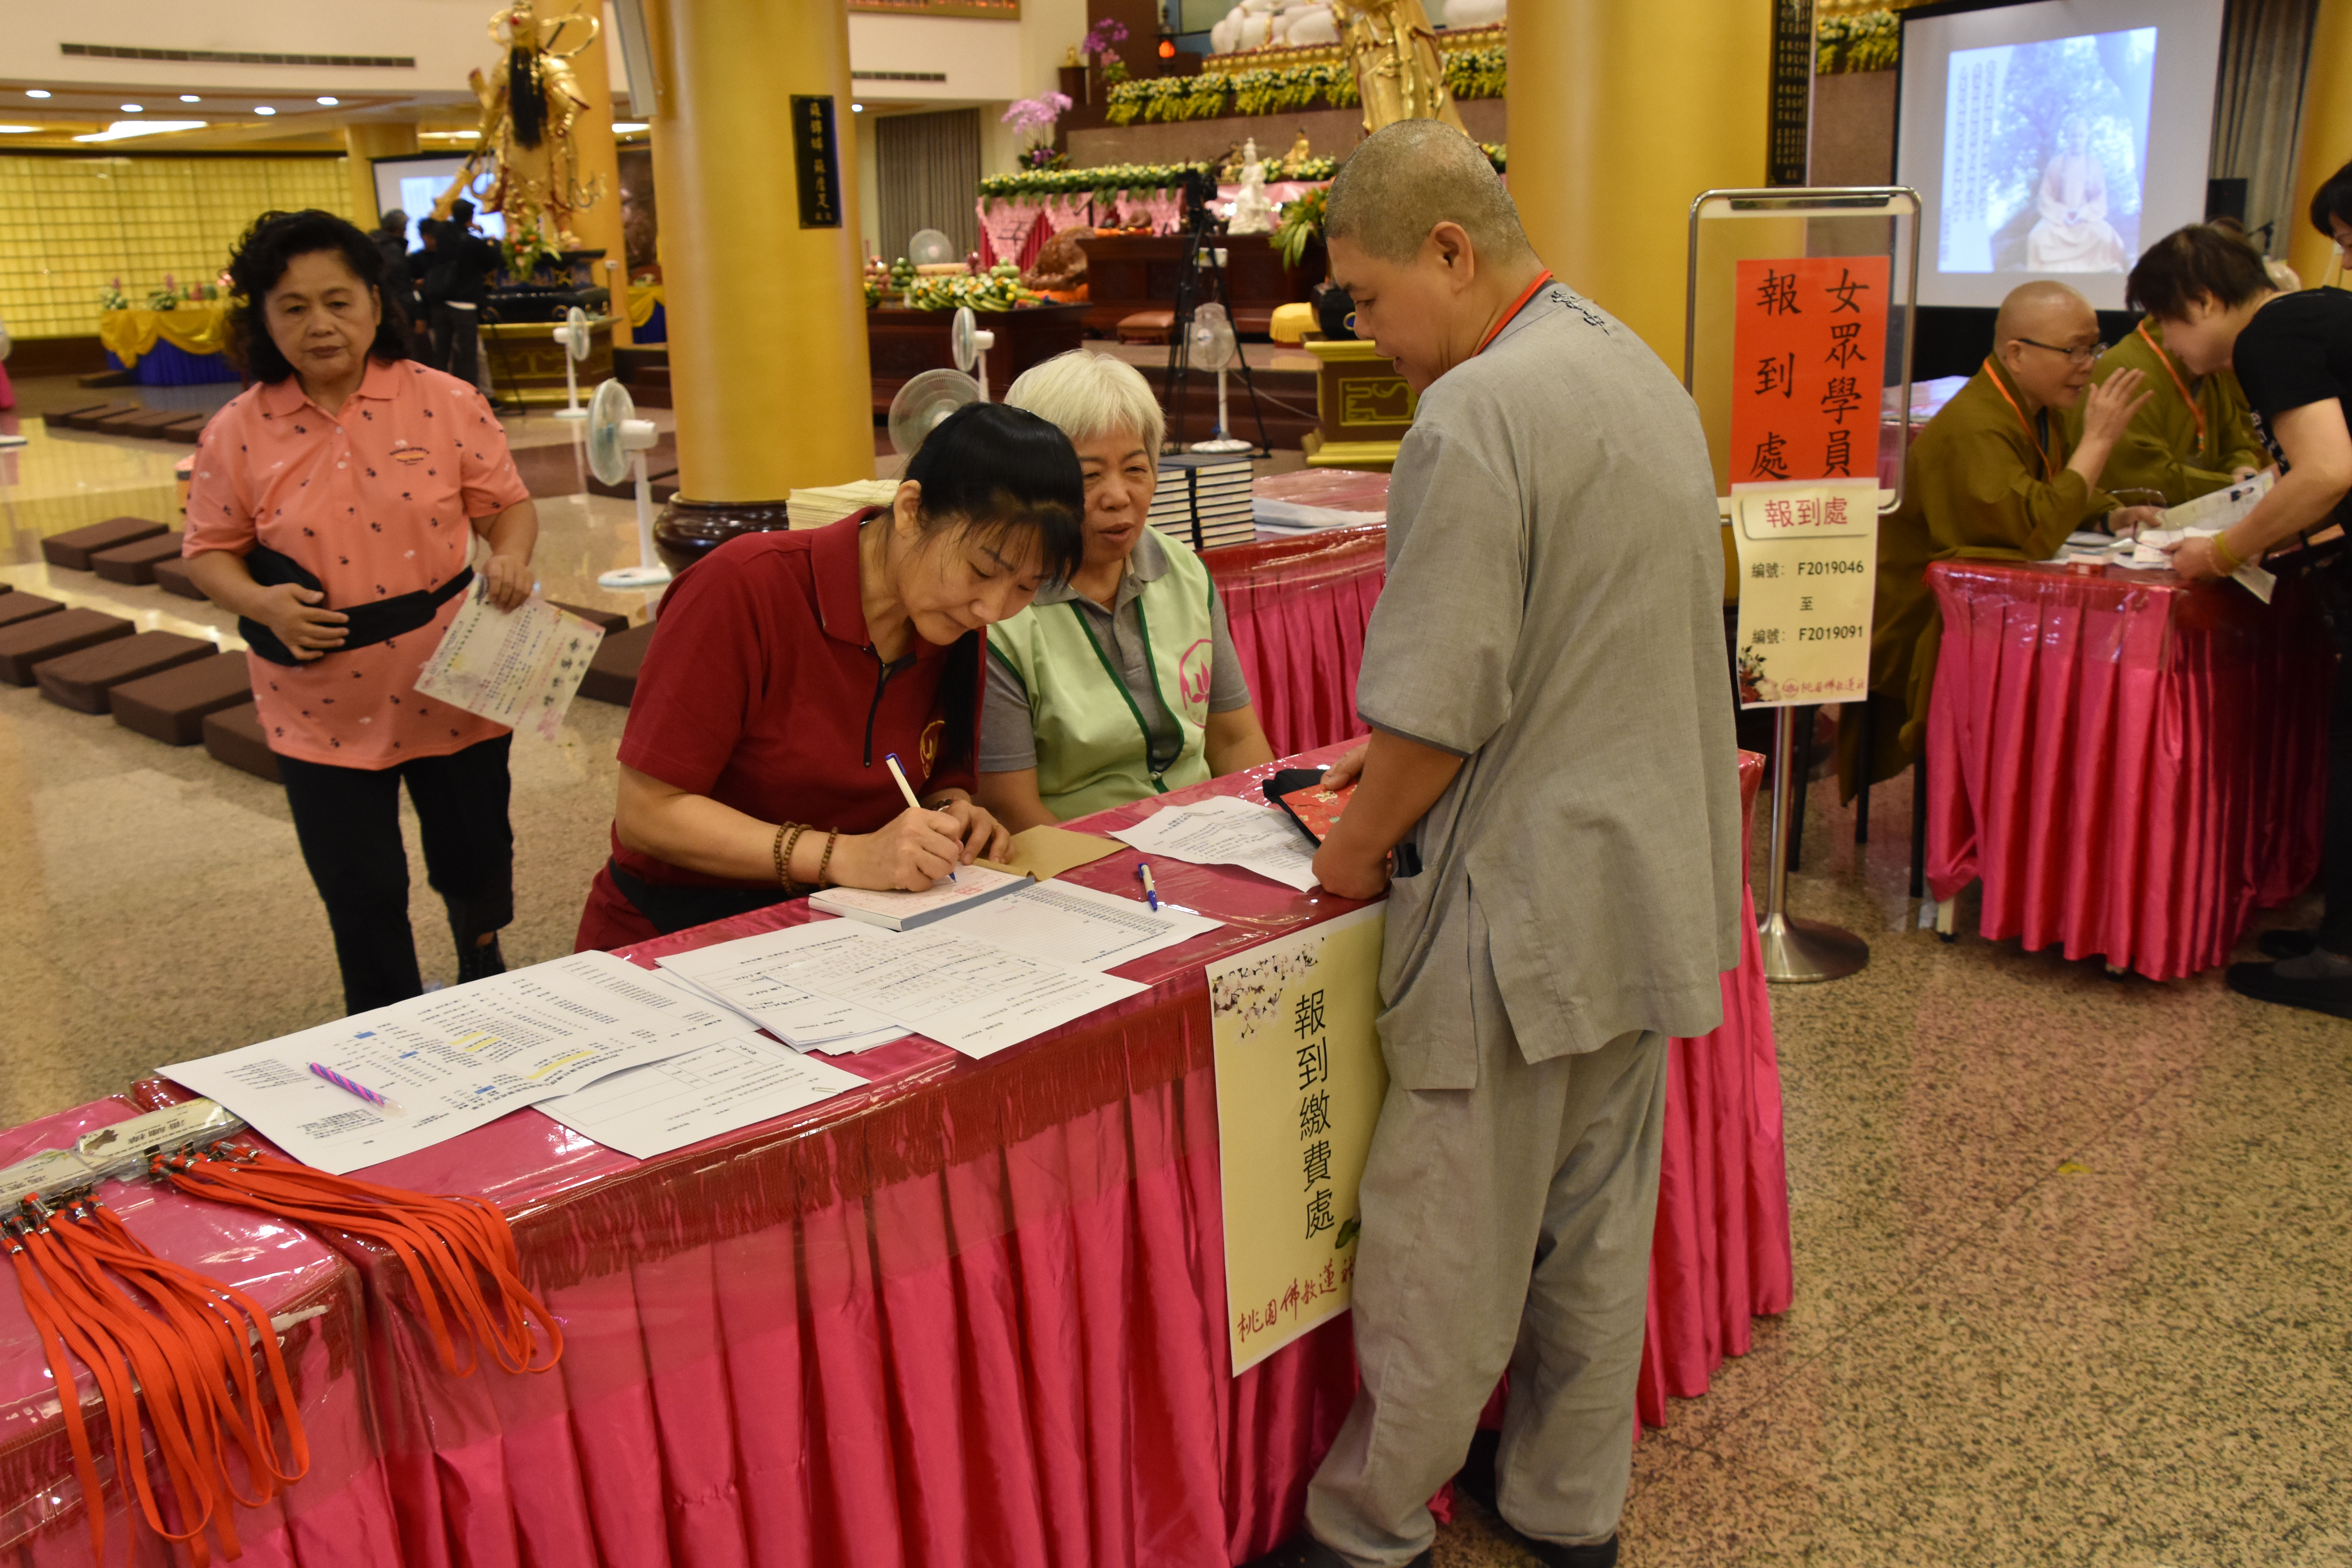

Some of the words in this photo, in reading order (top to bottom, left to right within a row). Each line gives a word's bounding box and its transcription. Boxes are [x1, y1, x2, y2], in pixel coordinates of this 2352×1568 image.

[1749, 269, 1802, 479] 報到處
[1821, 268, 1869, 477] 女眾學員
[1764, 497, 1848, 528] 報到處
[1797, 561, 1864, 575] F2019046
[1800, 596, 1813, 611] 至
[1799, 625, 1863, 641] F2019091
[1294, 989, 1334, 1240] 報到繳費處
